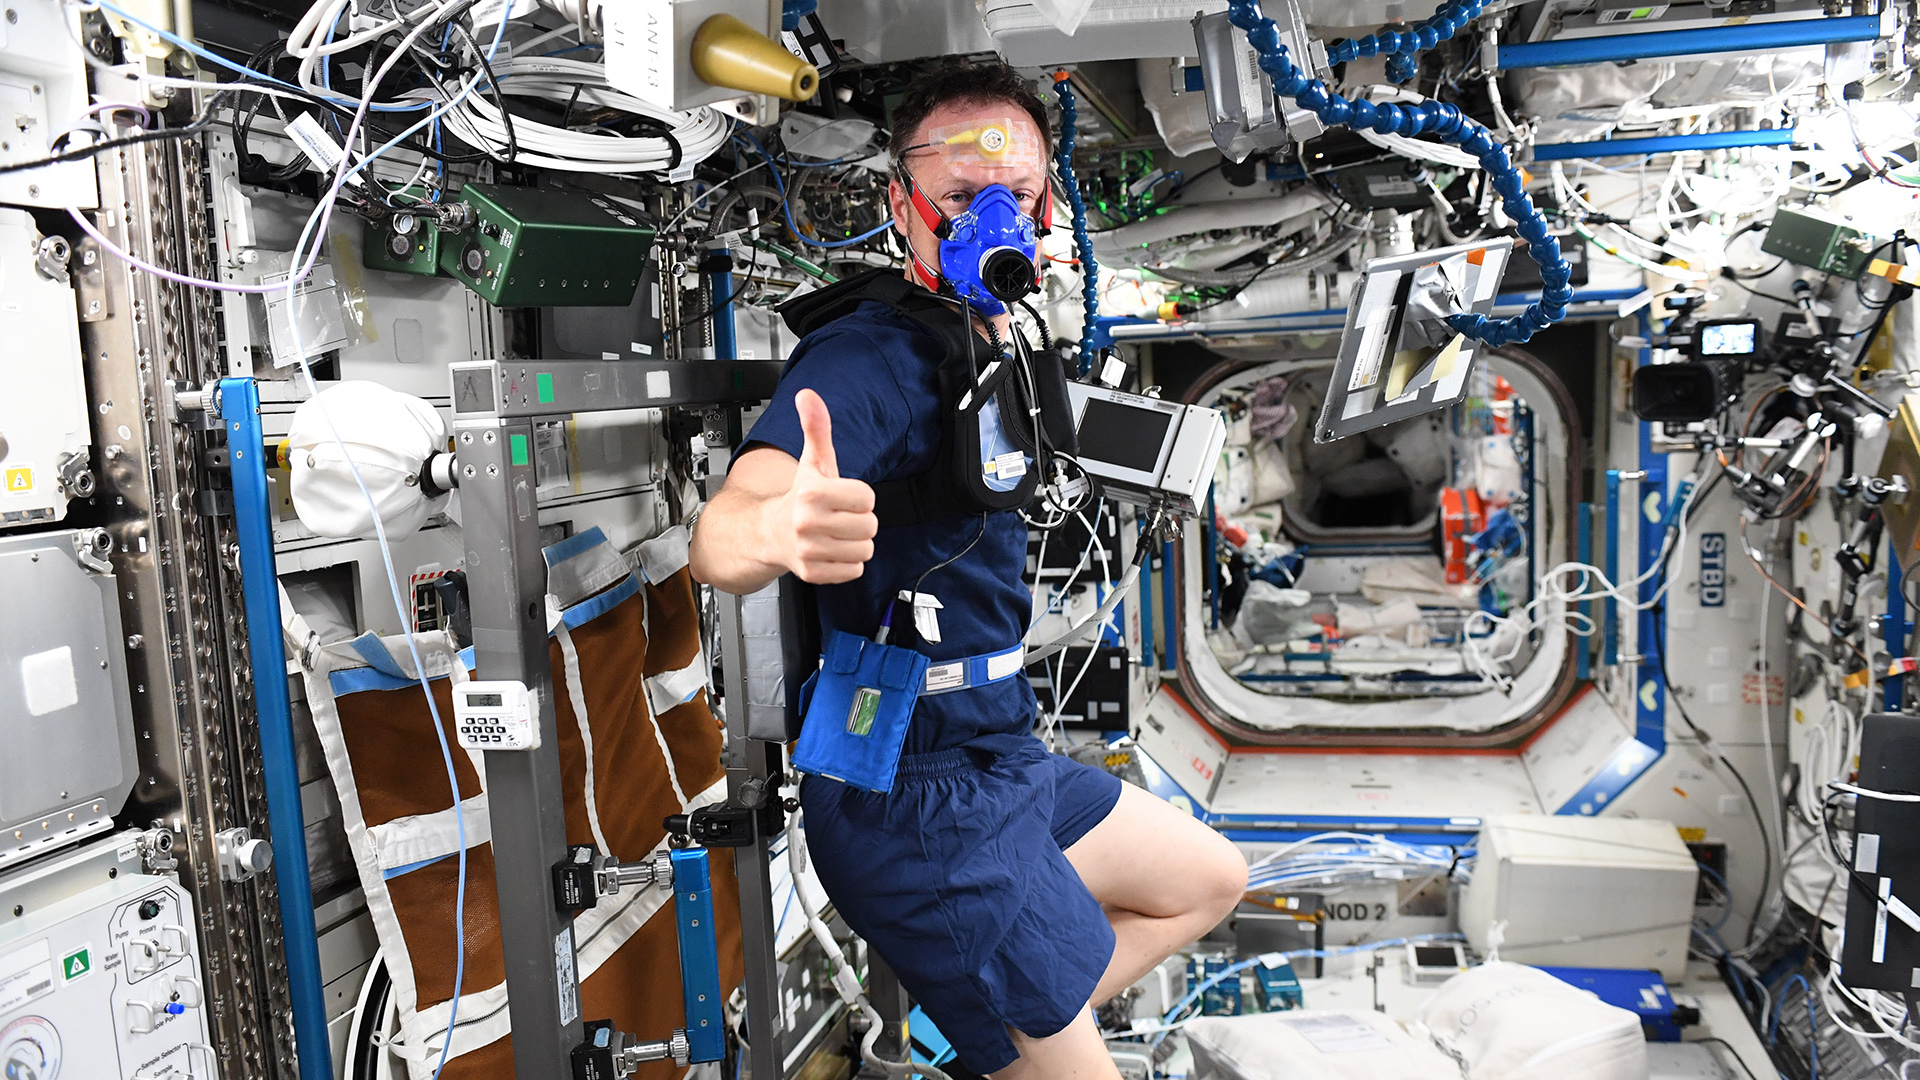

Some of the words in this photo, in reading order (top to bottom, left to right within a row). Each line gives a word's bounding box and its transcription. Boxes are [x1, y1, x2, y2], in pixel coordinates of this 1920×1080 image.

[614, 22, 624, 46] J1
[648, 12, 659, 88] ANT-13
[17, 477, 22, 485] 2
[1701, 537, 1725, 604] STBD
[1324, 903, 1368, 920] NOD
[1375, 903, 1386, 920] 2
[115, 930, 129, 939] Pump
[139, 925, 157, 936] Primary
[105, 953, 118, 962] Water
[74, 962, 80, 971] 0
[104, 959, 122, 971] Sample
[154, 1019, 164, 1030] ple
[165, 1014, 177, 1025] Port
[140, 1056, 160, 1070] Sample
[161, 1043, 182, 1058] Selector
[153, 1064, 173, 1078] Sample
